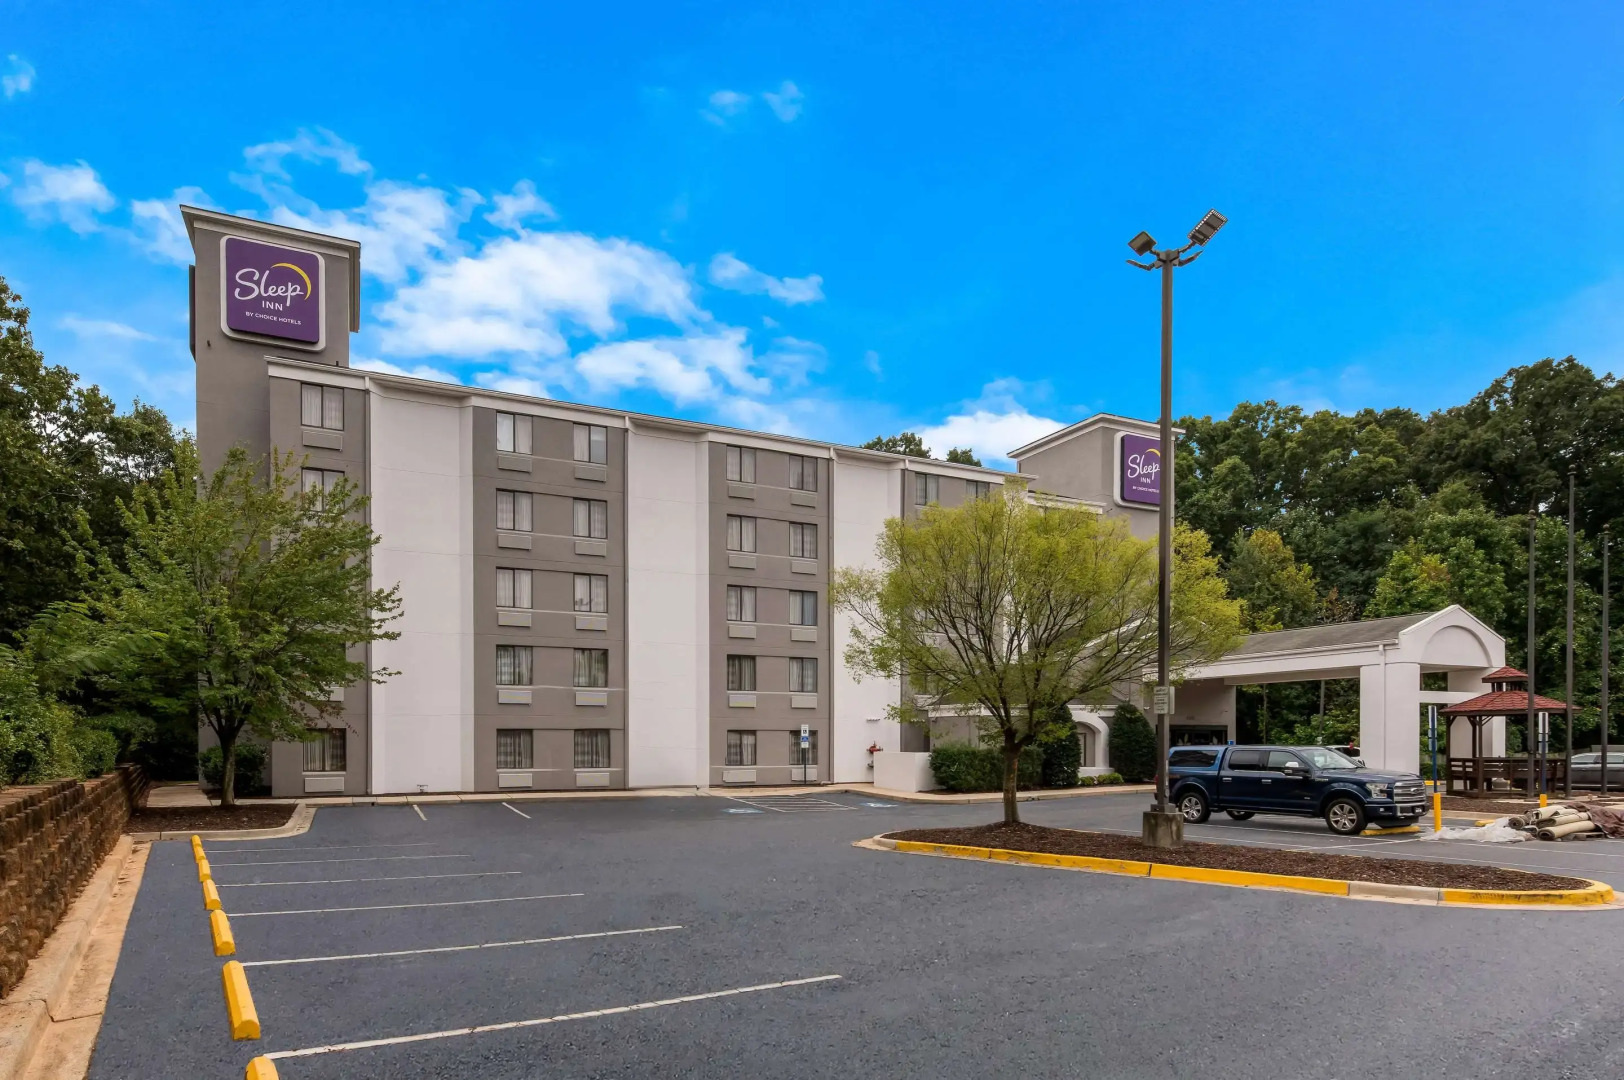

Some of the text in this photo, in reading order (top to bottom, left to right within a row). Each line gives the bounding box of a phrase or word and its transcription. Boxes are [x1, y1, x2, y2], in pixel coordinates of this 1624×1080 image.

[234, 268, 304, 306] Sleep
[262, 300, 283, 311] INN
[255, 313, 278, 321] CHOICE
[279, 317, 302, 325] HOTELS
[1128, 454, 1160, 480] Sleep
